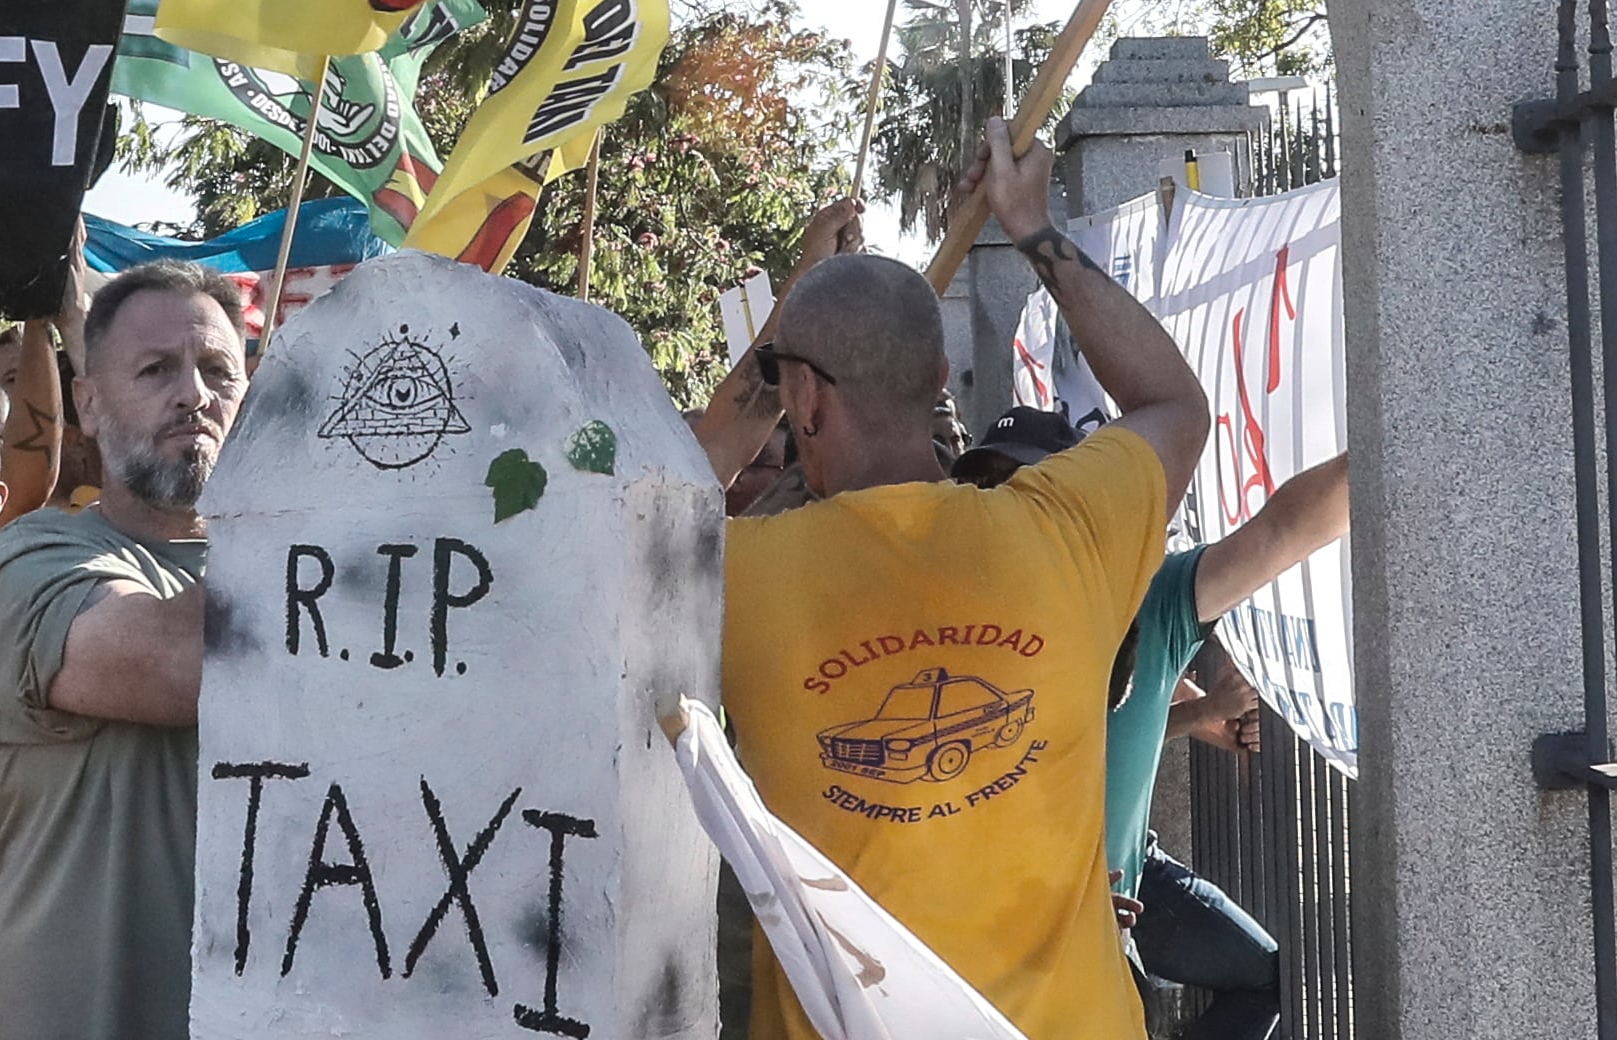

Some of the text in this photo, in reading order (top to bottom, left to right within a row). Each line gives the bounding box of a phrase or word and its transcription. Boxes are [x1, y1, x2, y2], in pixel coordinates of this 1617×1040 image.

[286, 537, 495, 677] R.I.P.
[803, 623, 1045, 696] SOLIDARIDAD
[821, 738, 1049, 824] SIEMPRE AL FRENTE
[212, 761, 599, 1040] TAXI
